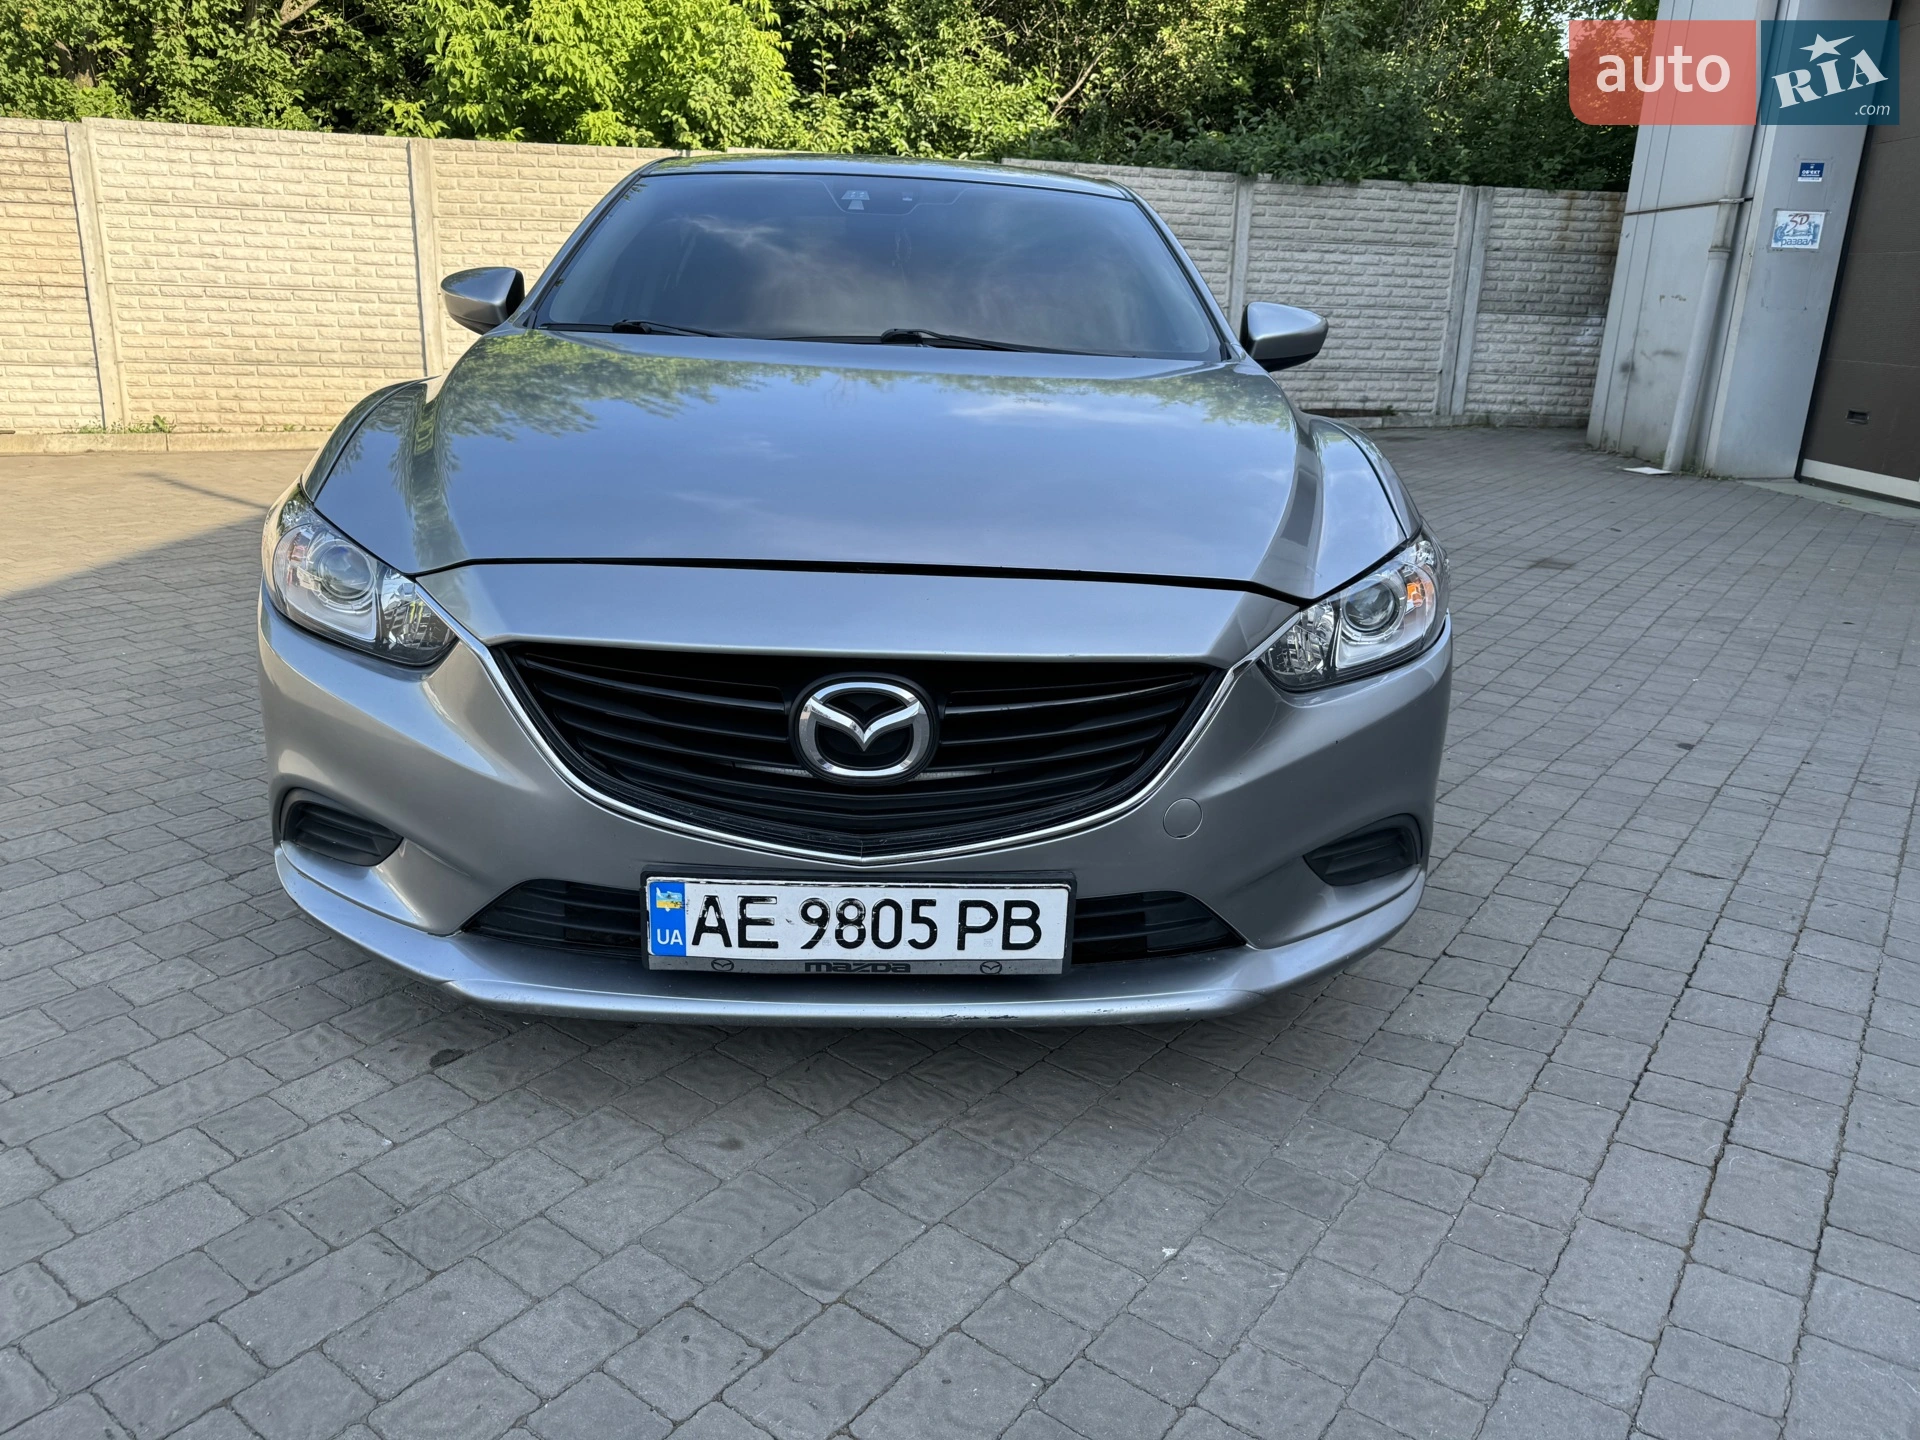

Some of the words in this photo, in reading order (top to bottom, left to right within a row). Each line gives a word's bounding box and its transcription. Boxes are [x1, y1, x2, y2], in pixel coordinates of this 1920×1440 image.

[1786, 213, 1810, 234] 3D
[691, 894, 780, 950] AE
[799, 897, 939, 950] 9805
[956, 899, 1043, 951] PB
[656, 928, 684, 946] UA
